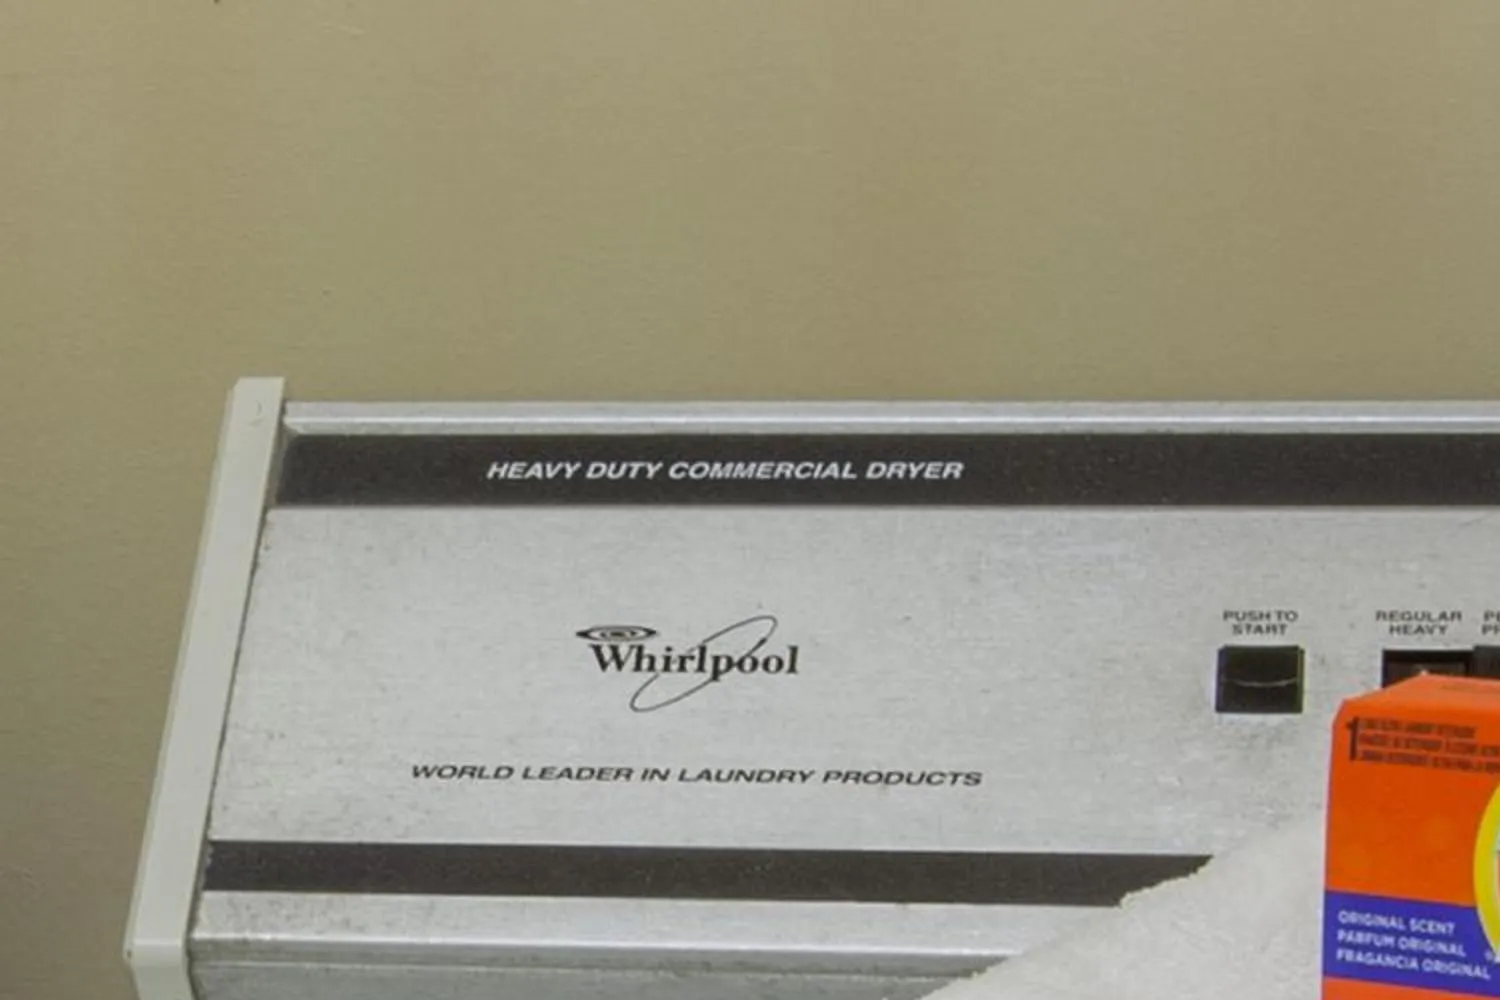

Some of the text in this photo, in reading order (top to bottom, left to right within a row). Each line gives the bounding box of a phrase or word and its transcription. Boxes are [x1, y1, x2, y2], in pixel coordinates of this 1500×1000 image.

[487, 462, 964, 479] HEAVY DUTY COMMERCIAL DRYER
[1223, 610, 1298, 621] PUSH TO
[1376, 610, 1462, 622] REGULAR
[1232, 624, 1287, 635] START
[1389, 624, 1447, 635] HEAVY
[589, 644, 799, 681] Whirlpool
[411, 765, 982, 787] WORLD LEADER IN LAUNDRY PRODUCTS
[1338, 911, 1455, 935] ORIGINAL SCENT
[1337, 929, 1466, 957] PARFUM ORIGINAL
[1336, 948, 1491, 980] FRAGANCIA ORIGINAL
